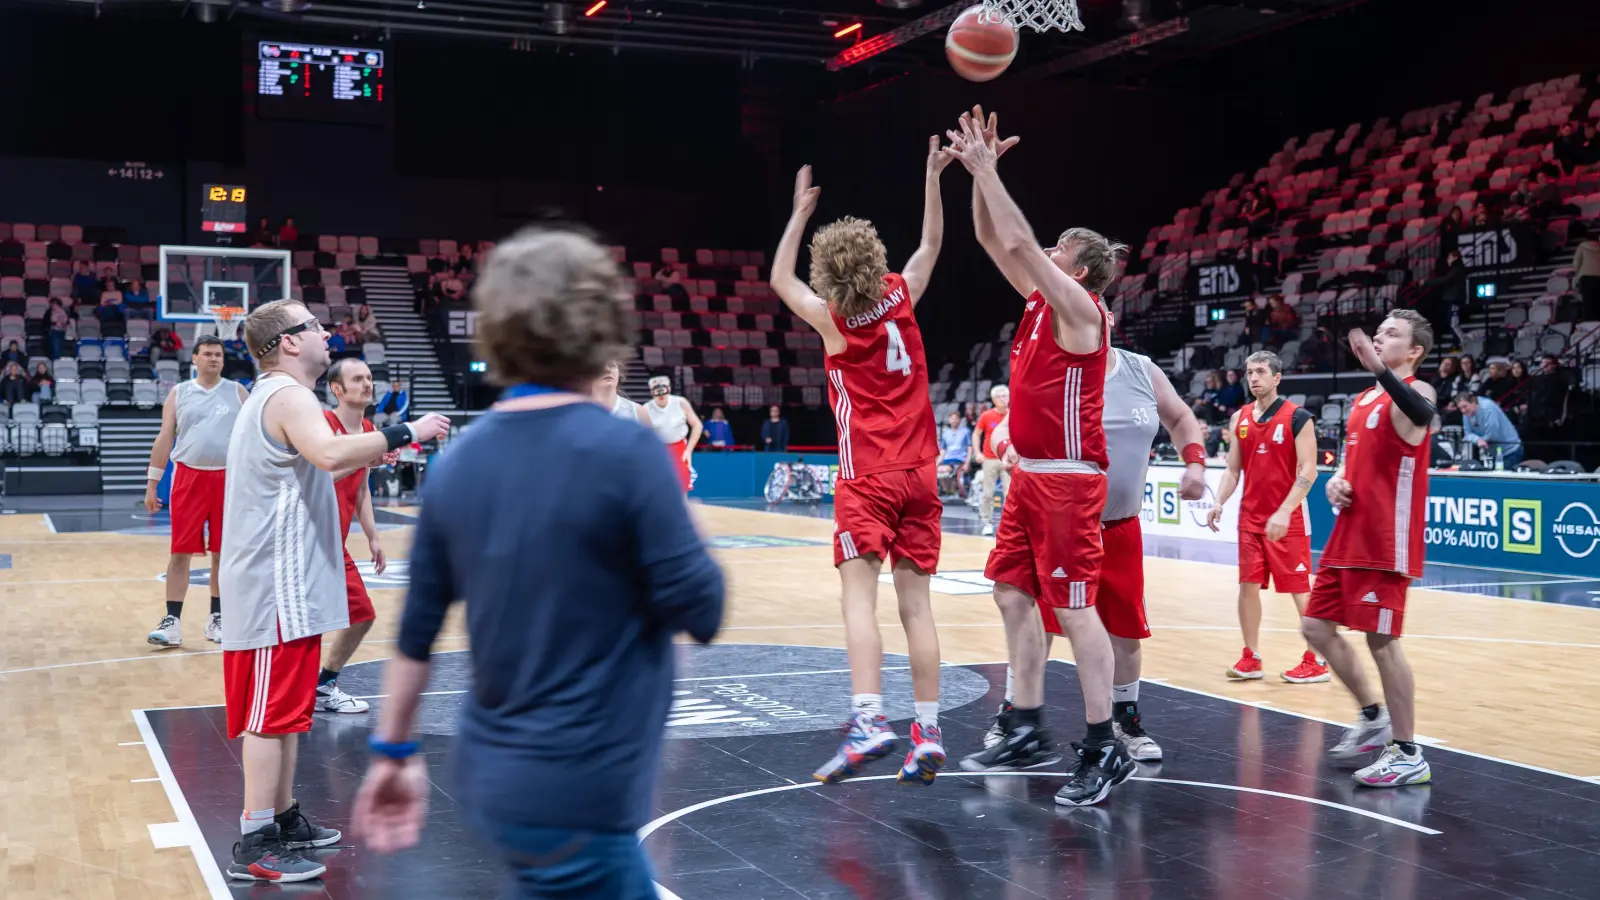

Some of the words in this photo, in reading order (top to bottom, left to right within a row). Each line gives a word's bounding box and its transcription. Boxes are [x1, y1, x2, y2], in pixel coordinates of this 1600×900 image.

[845, 285, 906, 329] GERMANY
[885, 318, 912, 376] 4
[215, 405, 229, 415] 20
[1131, 407, 1150, 426] 33
[1365, 403, 1385, 429] 6
[1272, 423, 1285, 445] 4
[1163, 491, 1175, 515] S
[1187, 501, 1213, 509] NISSA
[1424, 495, 1498, 527] ITNER
[1423, 526, 1457, 547] 00%
[1458, 529, 1499, 550] AUTO
[1511, 510, 1533, 542] S
